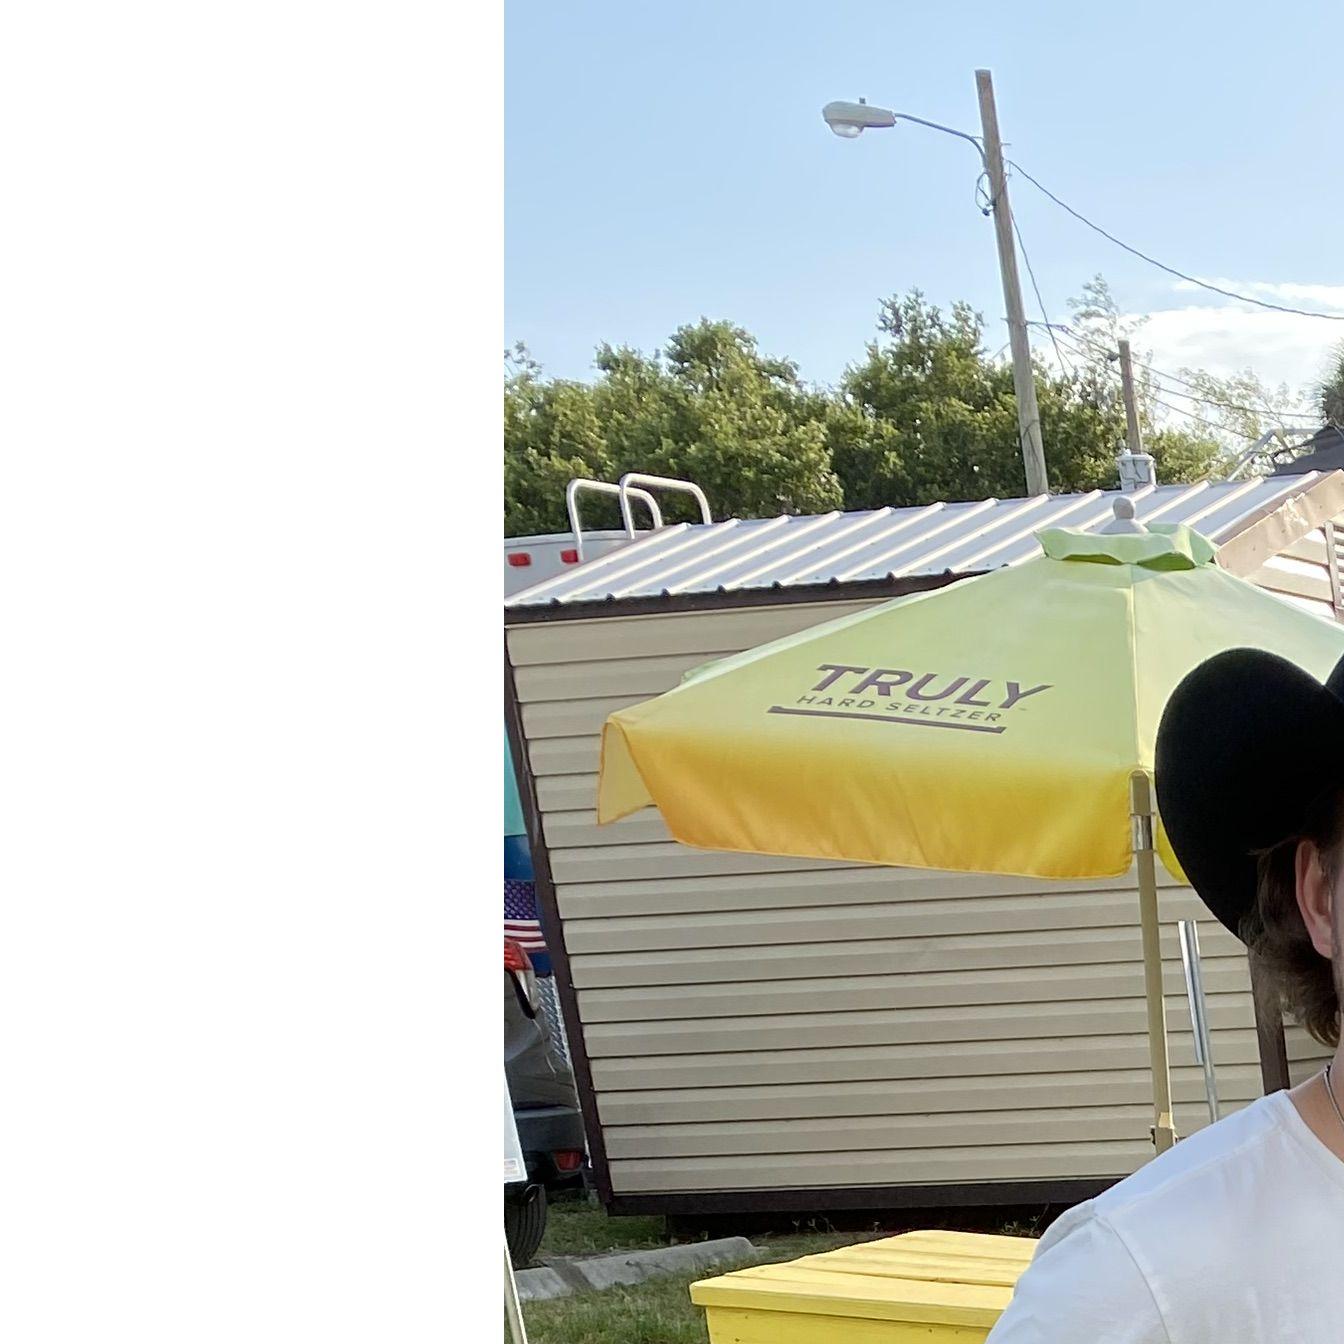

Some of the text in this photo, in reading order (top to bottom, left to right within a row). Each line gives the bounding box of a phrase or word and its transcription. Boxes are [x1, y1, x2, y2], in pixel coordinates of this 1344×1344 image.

[811, 664, 1054, 709] TRULY
[796, 695, 1002, 722] HARD SELTZER
